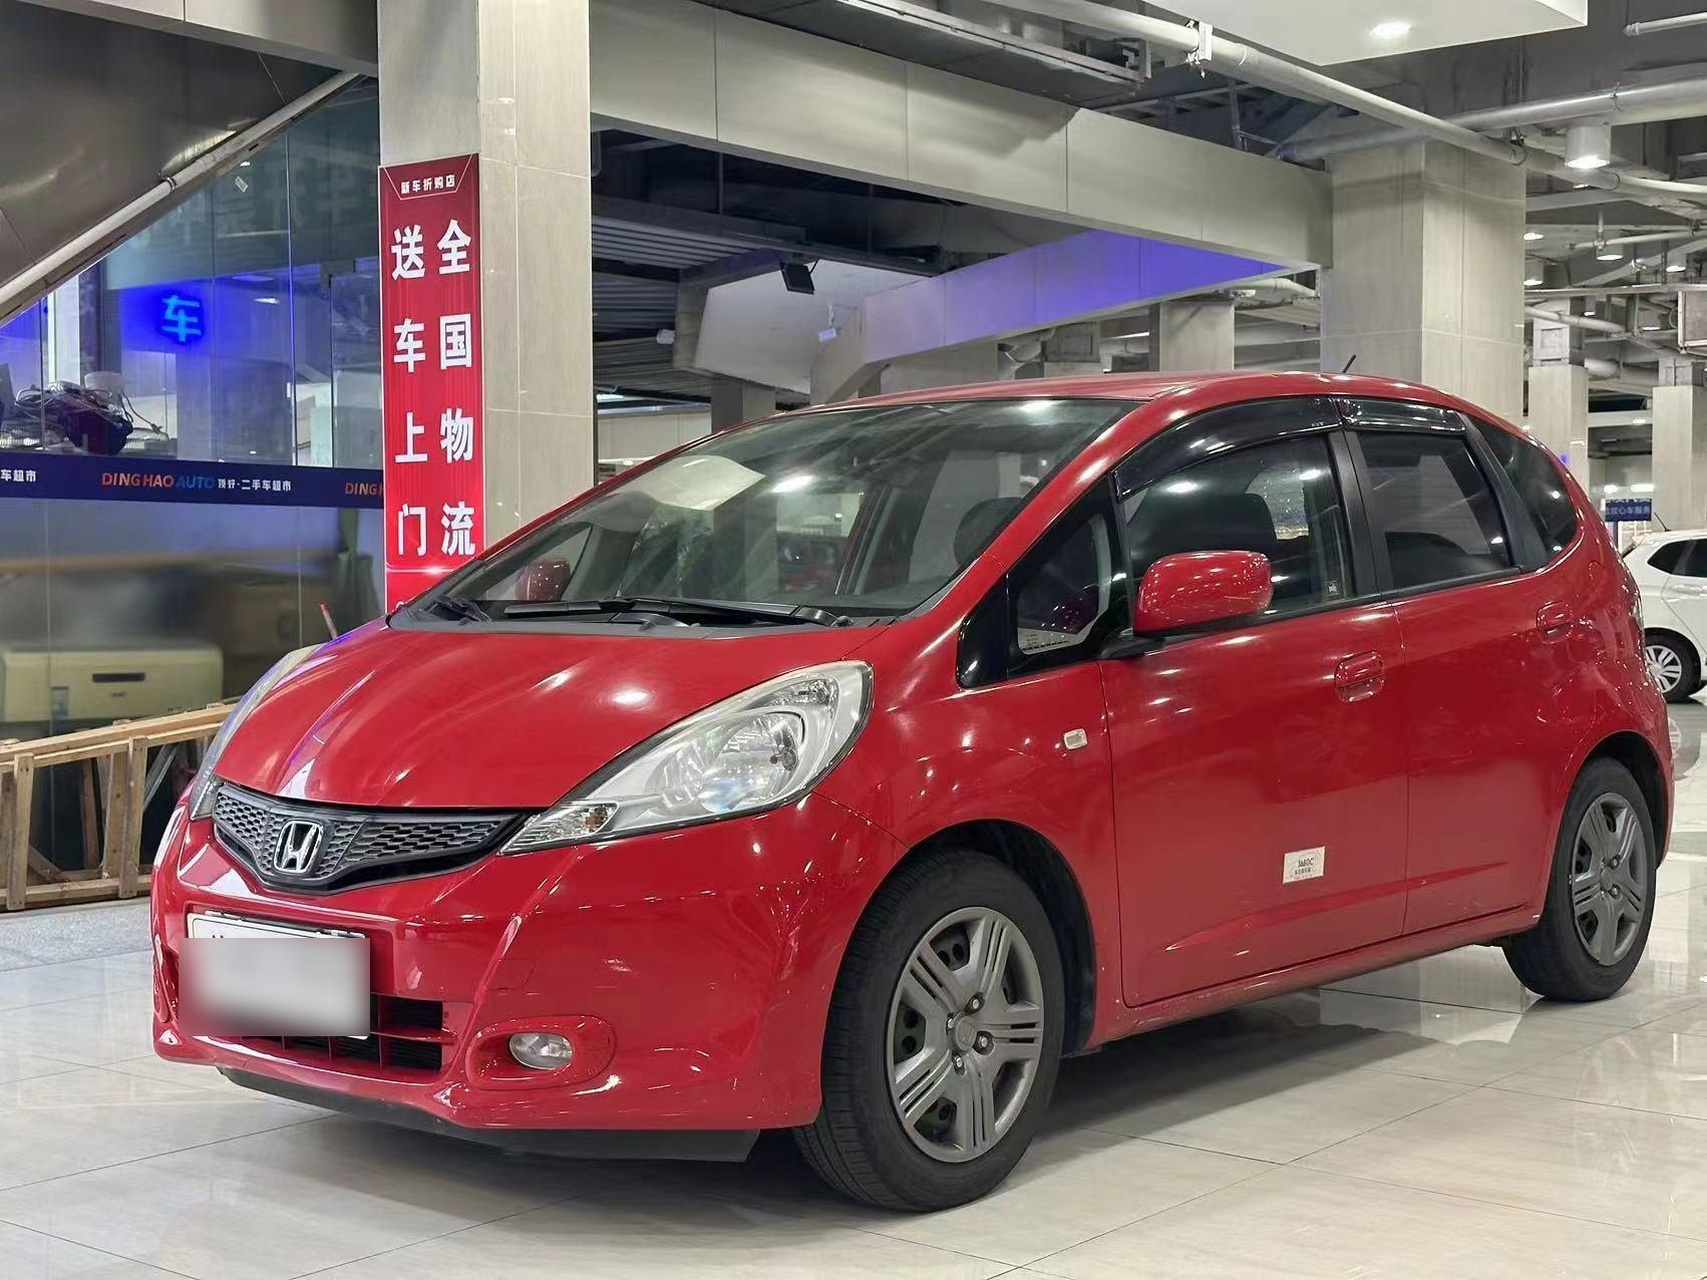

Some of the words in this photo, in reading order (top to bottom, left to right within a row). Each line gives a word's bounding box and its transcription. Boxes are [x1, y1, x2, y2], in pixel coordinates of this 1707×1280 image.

[401, 174, 455, 195] 新车折购店
[161, 295, 202, 342] 车
[390, 223, 429, 557] 送车上门
[437, 218, 476, 556] 全国物流
[175, 475, 216, 489] AUTO
